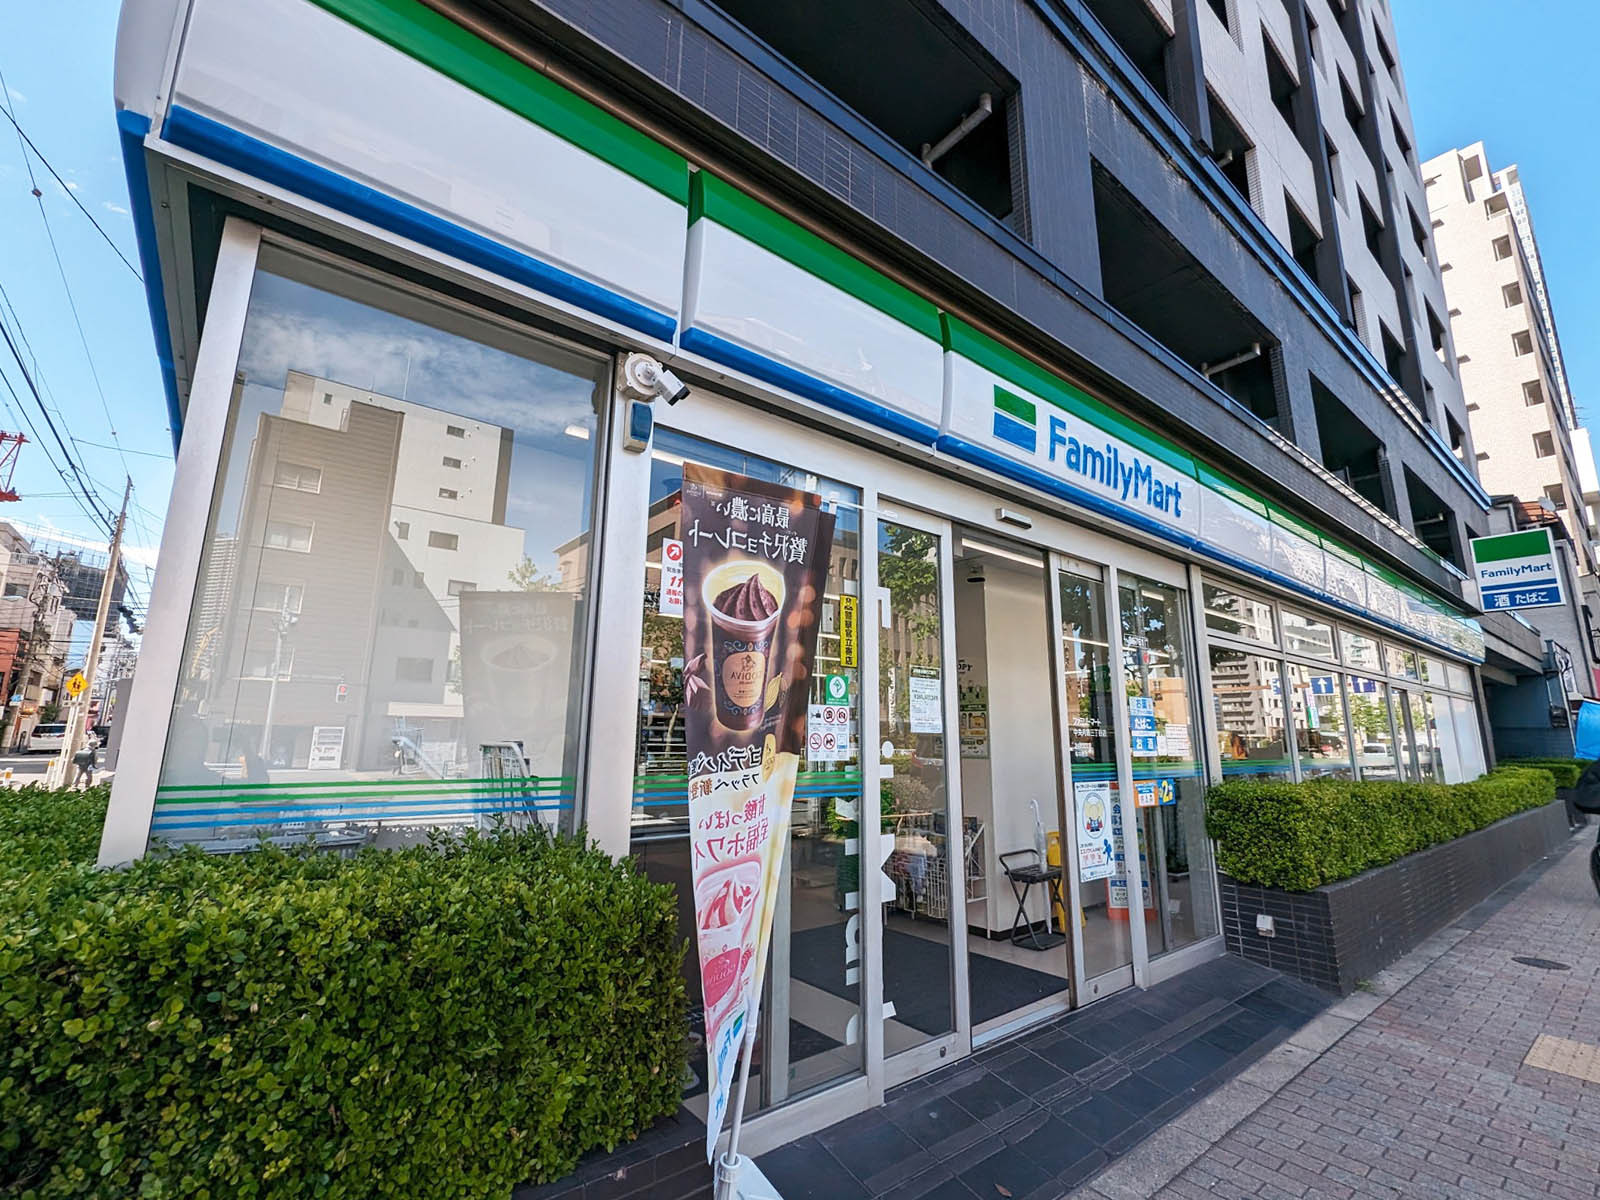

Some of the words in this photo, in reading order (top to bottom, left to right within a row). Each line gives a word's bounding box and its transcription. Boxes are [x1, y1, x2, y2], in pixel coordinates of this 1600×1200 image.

[1048, 414, 1182, 518] FamilyMart
[1481, 562, 1552, 578] FamilyMart
[1493, 593, 1510, 607] 酒
[1514, 591, 1549, 605] たばこ
